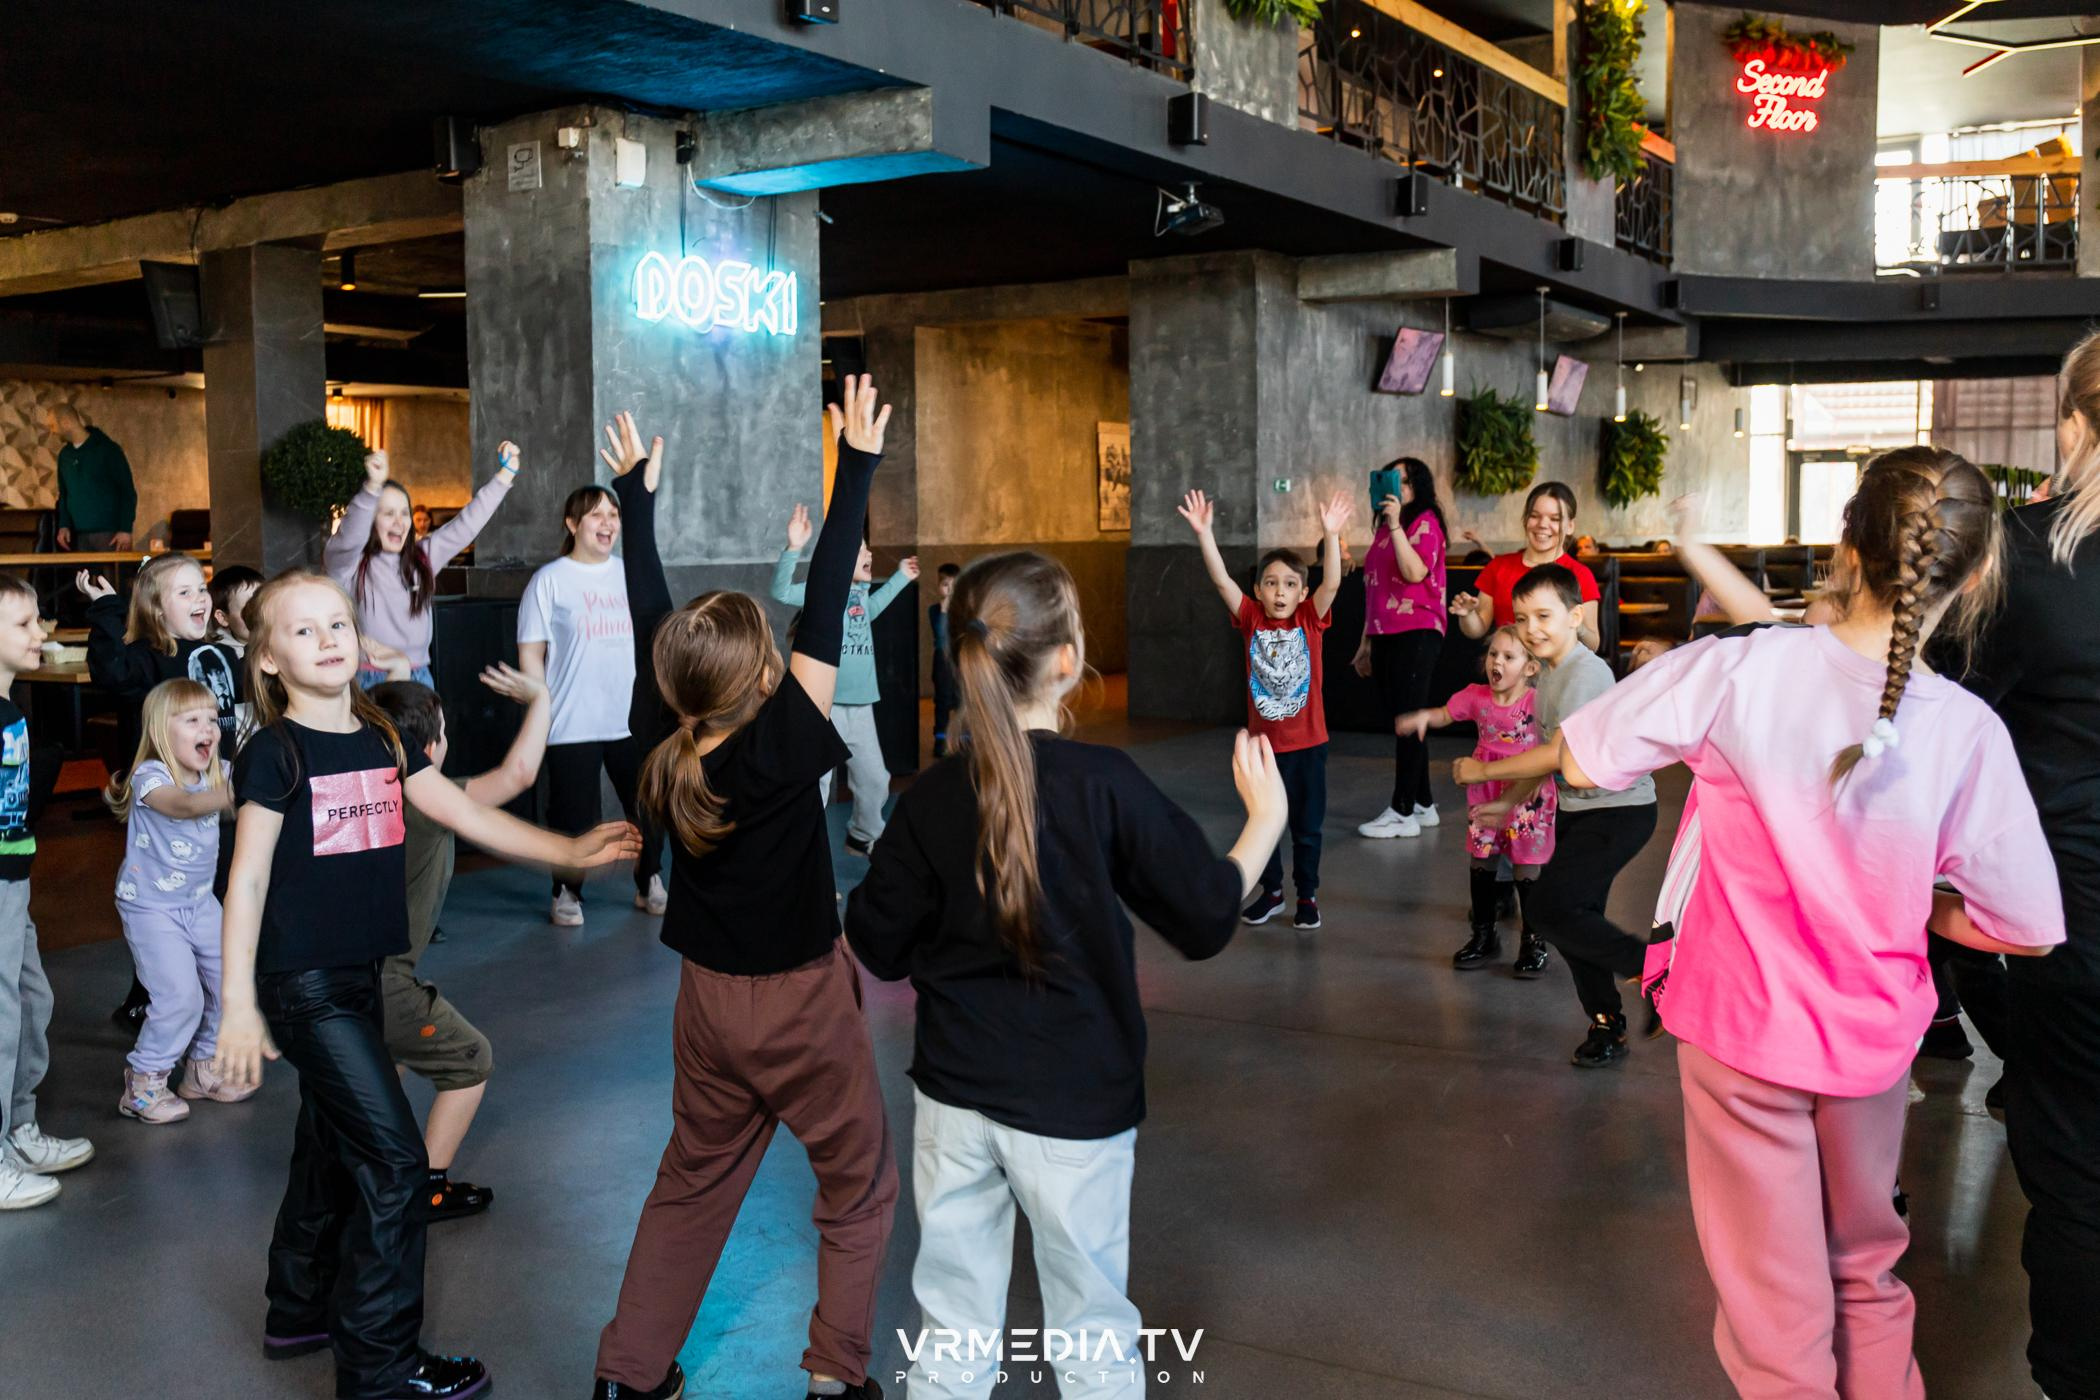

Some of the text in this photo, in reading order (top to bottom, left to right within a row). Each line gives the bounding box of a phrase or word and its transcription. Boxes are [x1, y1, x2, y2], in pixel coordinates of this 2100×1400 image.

[1737, 59, 1828, 99] Second
[1747, 94, 1818, 132] Floor
[634, 250, 798, 336] DOSKI
[327, 799, 399, 821] PERFECTLY
